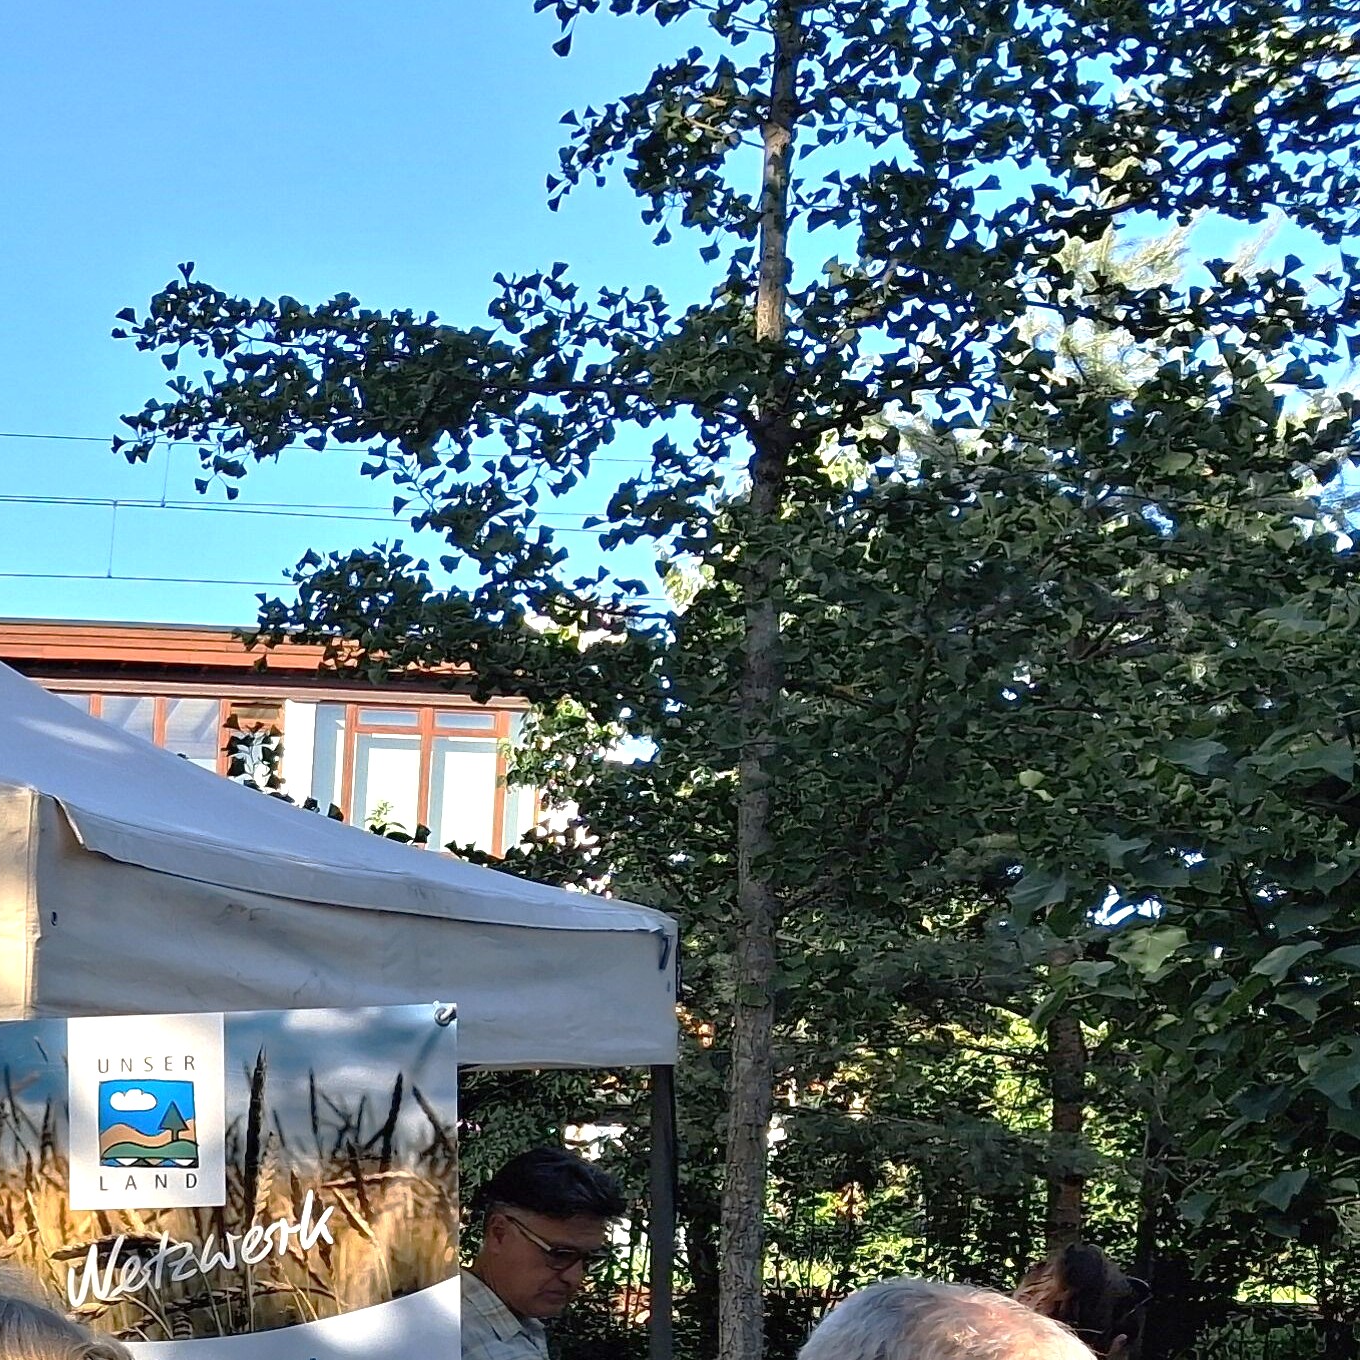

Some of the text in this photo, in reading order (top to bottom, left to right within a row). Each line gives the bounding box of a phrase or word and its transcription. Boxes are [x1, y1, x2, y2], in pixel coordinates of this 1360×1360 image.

[98, 1056, 195, 1074] UNSER
[100, 1174, 197, 1191] LAND
[68, 1190, 336, 1308] Netzwerk
